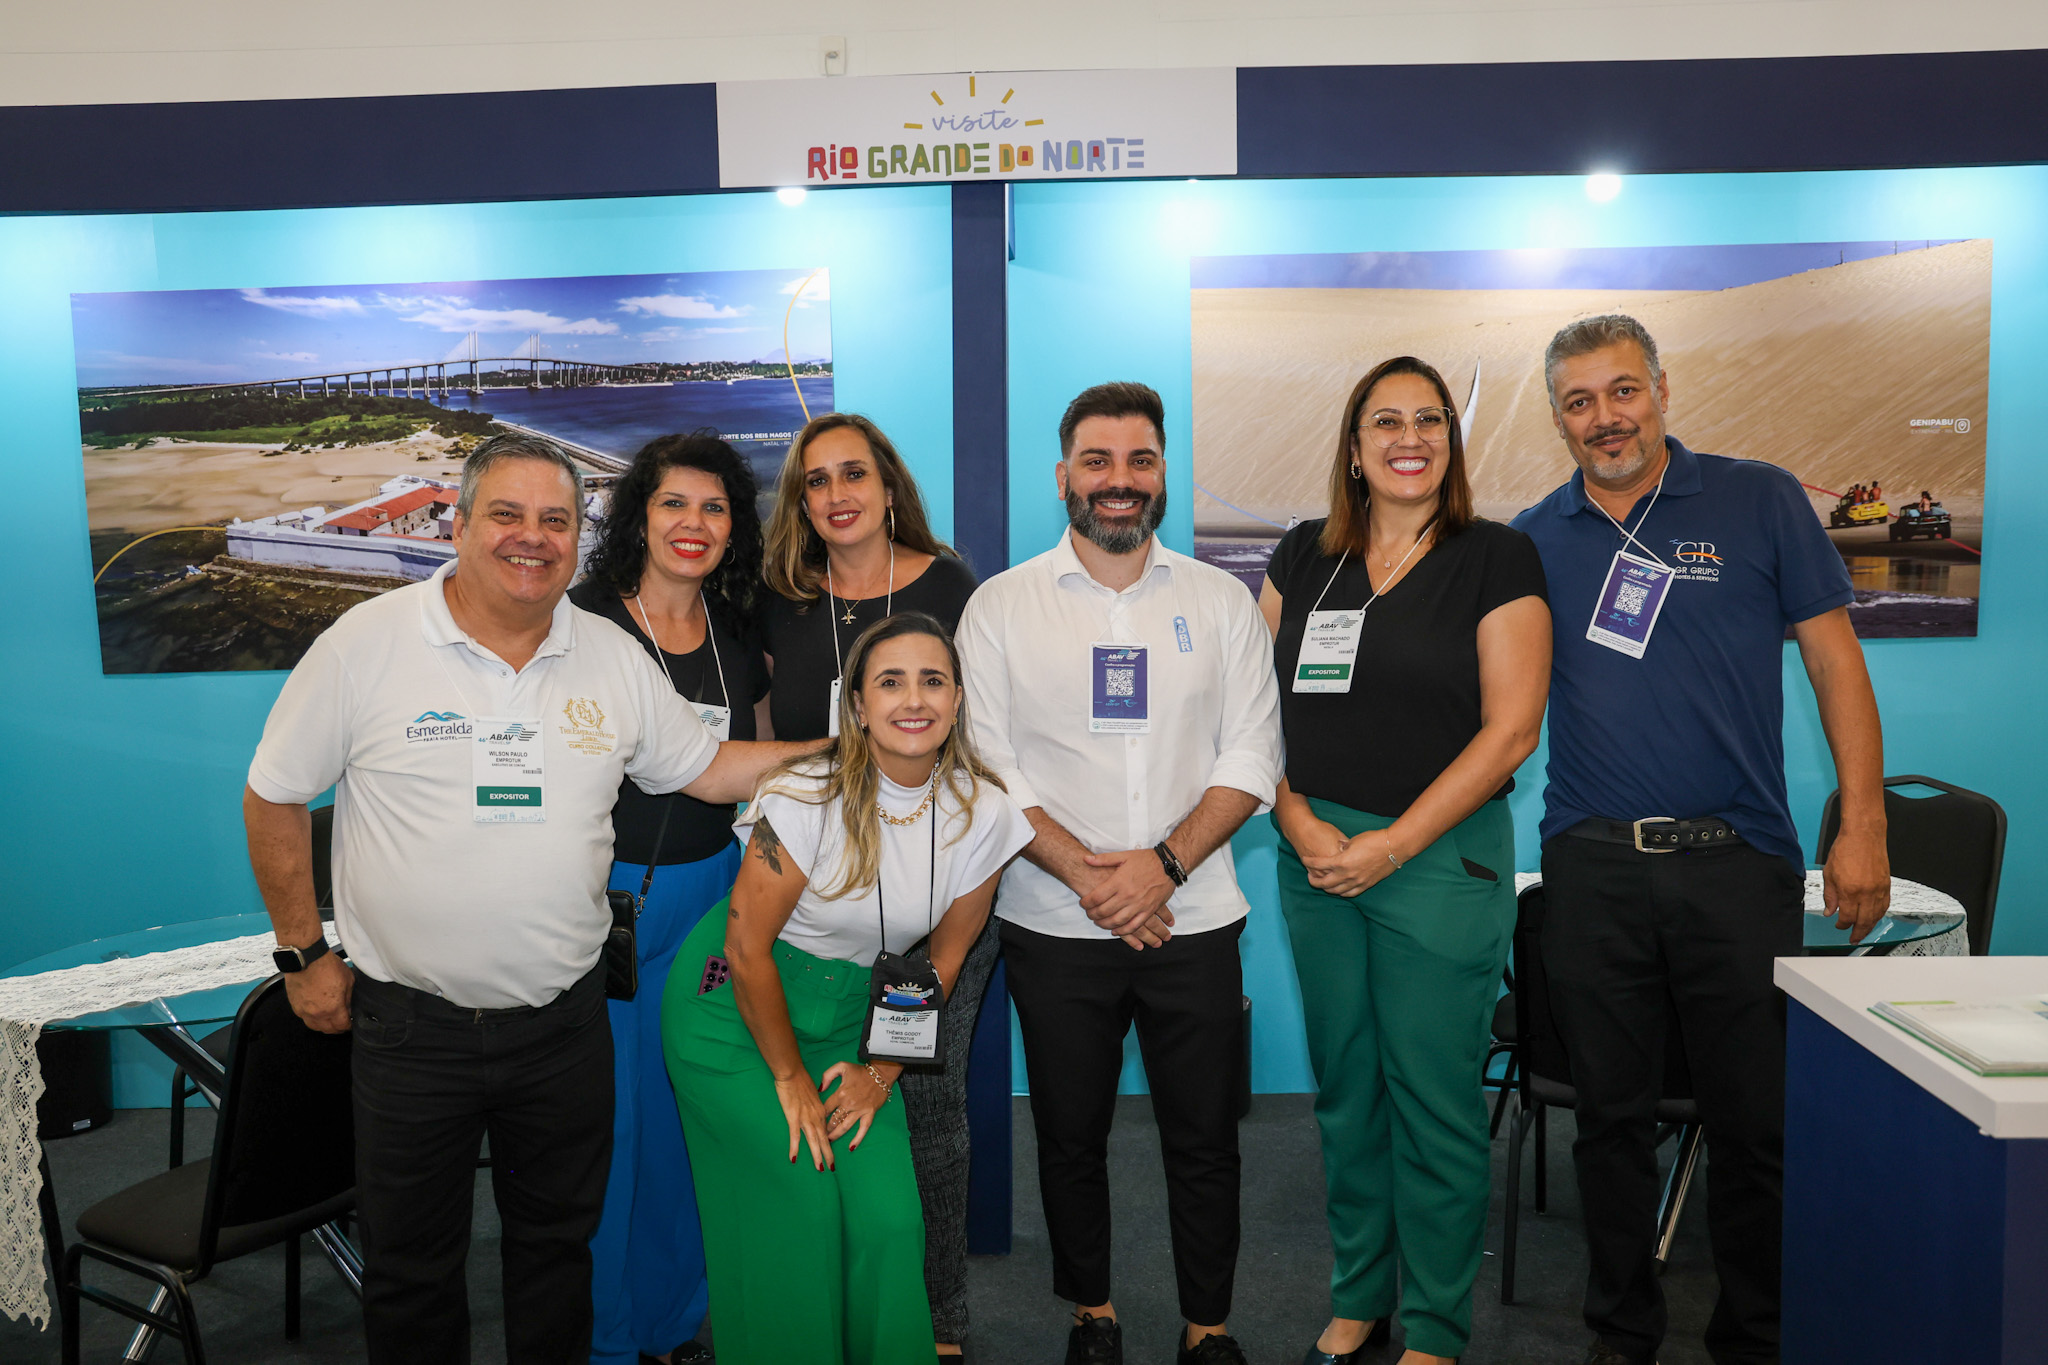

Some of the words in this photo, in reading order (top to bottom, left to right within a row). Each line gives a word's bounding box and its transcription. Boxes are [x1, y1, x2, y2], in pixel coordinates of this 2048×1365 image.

[932, 109, 1019, 132] visite
[868, 143, 990, 179] GRANDE
[1043, 137, 1145, 173] NORTE
[1910, 418, 1954, 426] GENIPABU
[754, 432, 769, 440] REIS
[769, 431, 792, 439] MAGOS
[1675, 541, 1725, 567] GR
[1674, 566, 1688, 575] GR
[1690, 566, 1720, 577] GRUPO
[406, 721, 473, 739] Esmeralda
[489, 733, 514, 741] ABAV
